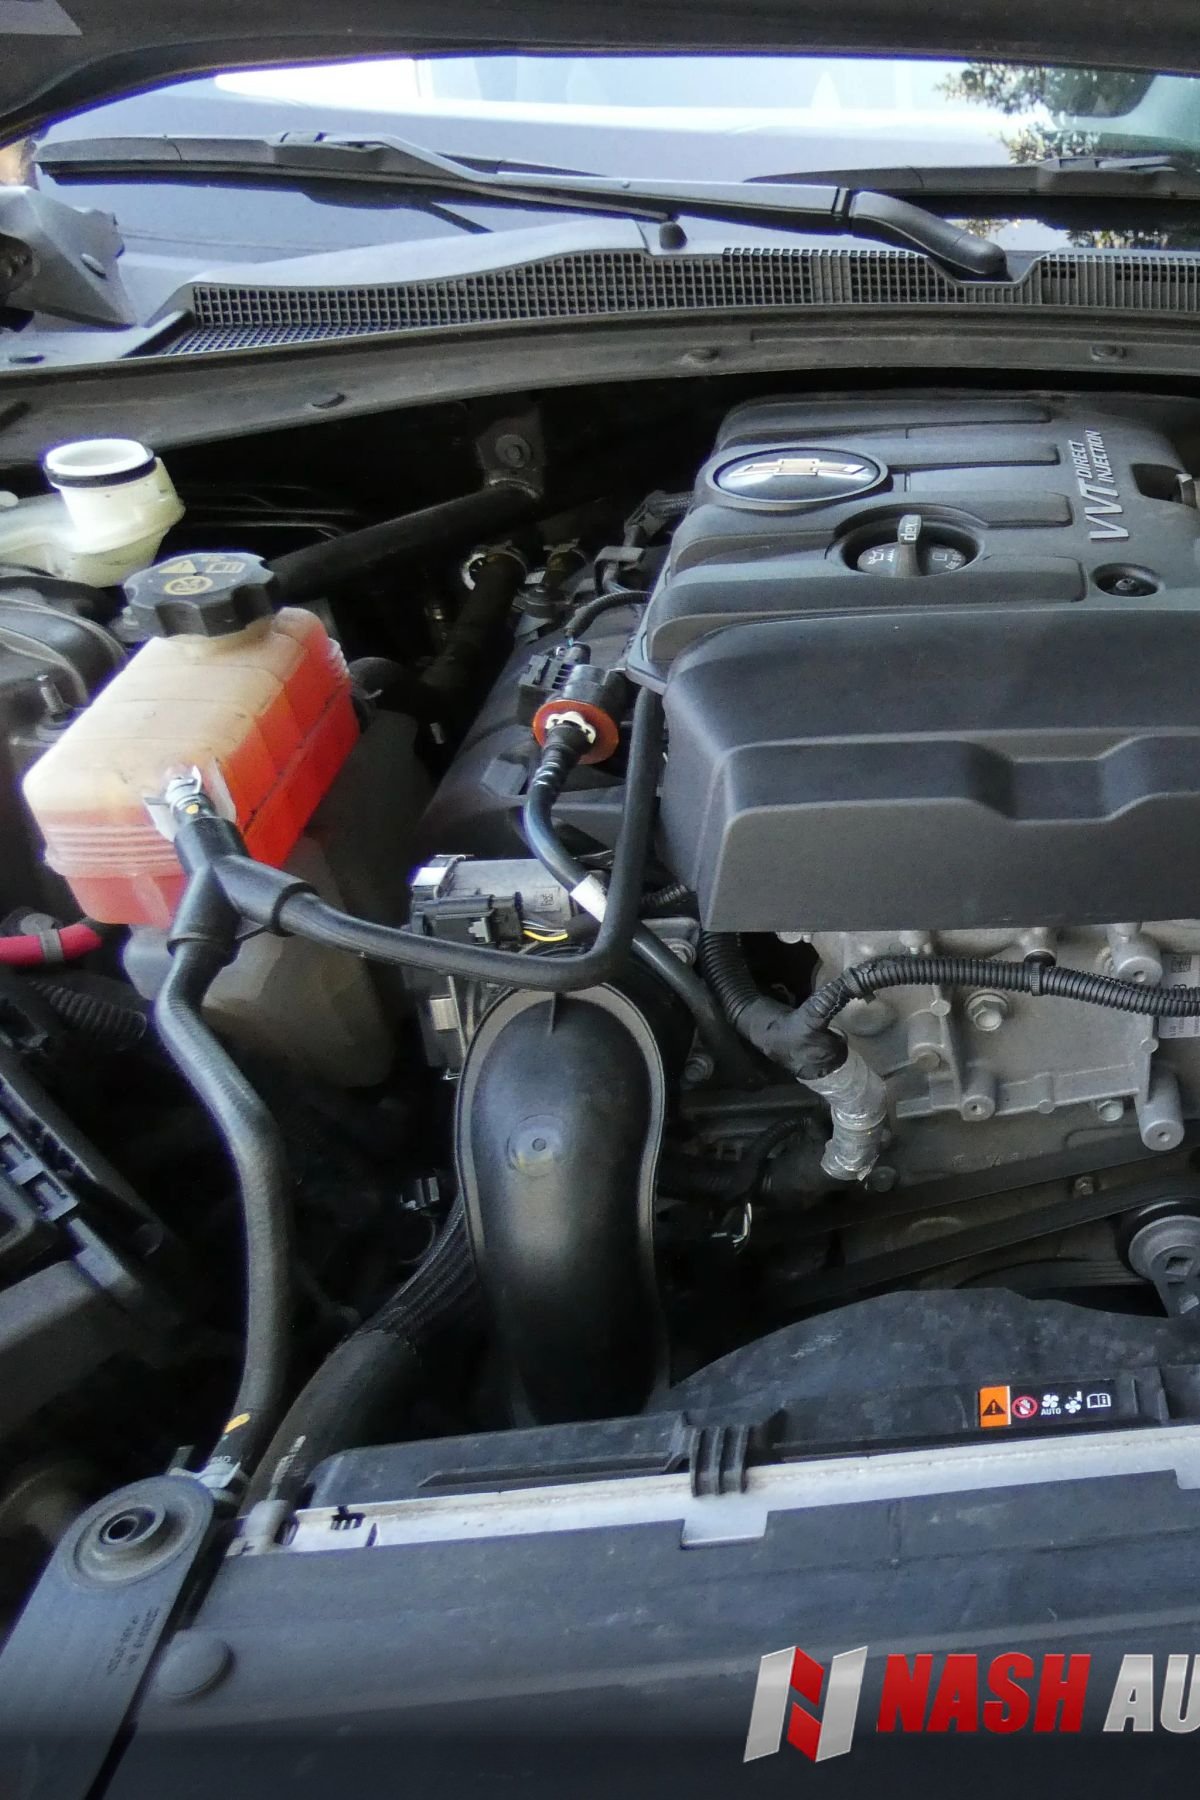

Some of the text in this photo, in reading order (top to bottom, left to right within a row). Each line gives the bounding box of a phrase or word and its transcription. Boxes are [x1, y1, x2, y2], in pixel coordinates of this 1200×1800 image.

[1068, 440, 1092, 479] DIRECT
[1085, 430, 1115, 484] INJECTION
[1078, 477, 1129, 539] VVT
[1041, 1407, 1061, 1416] AUTO
